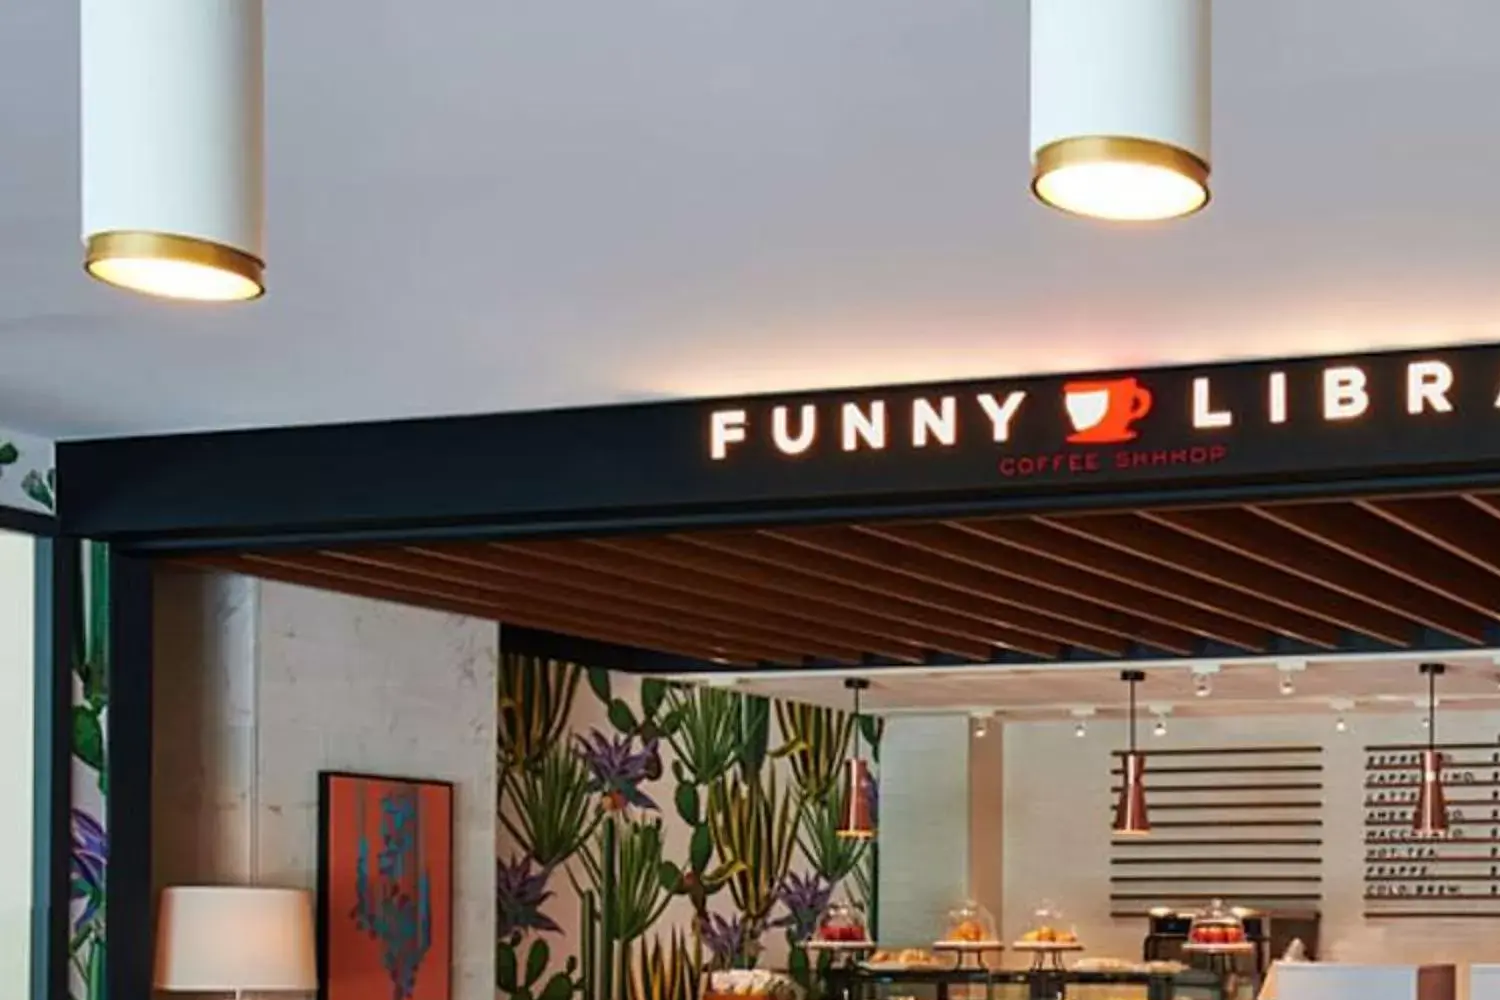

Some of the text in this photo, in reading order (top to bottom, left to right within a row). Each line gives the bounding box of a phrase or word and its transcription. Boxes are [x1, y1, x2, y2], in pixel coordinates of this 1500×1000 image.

[711, 390, 1026, 460] FUNNY
[999, 445, 1227, 477] COFFEE SHHHOP
[1366, 770, 1475, 784] CAPPUINO
